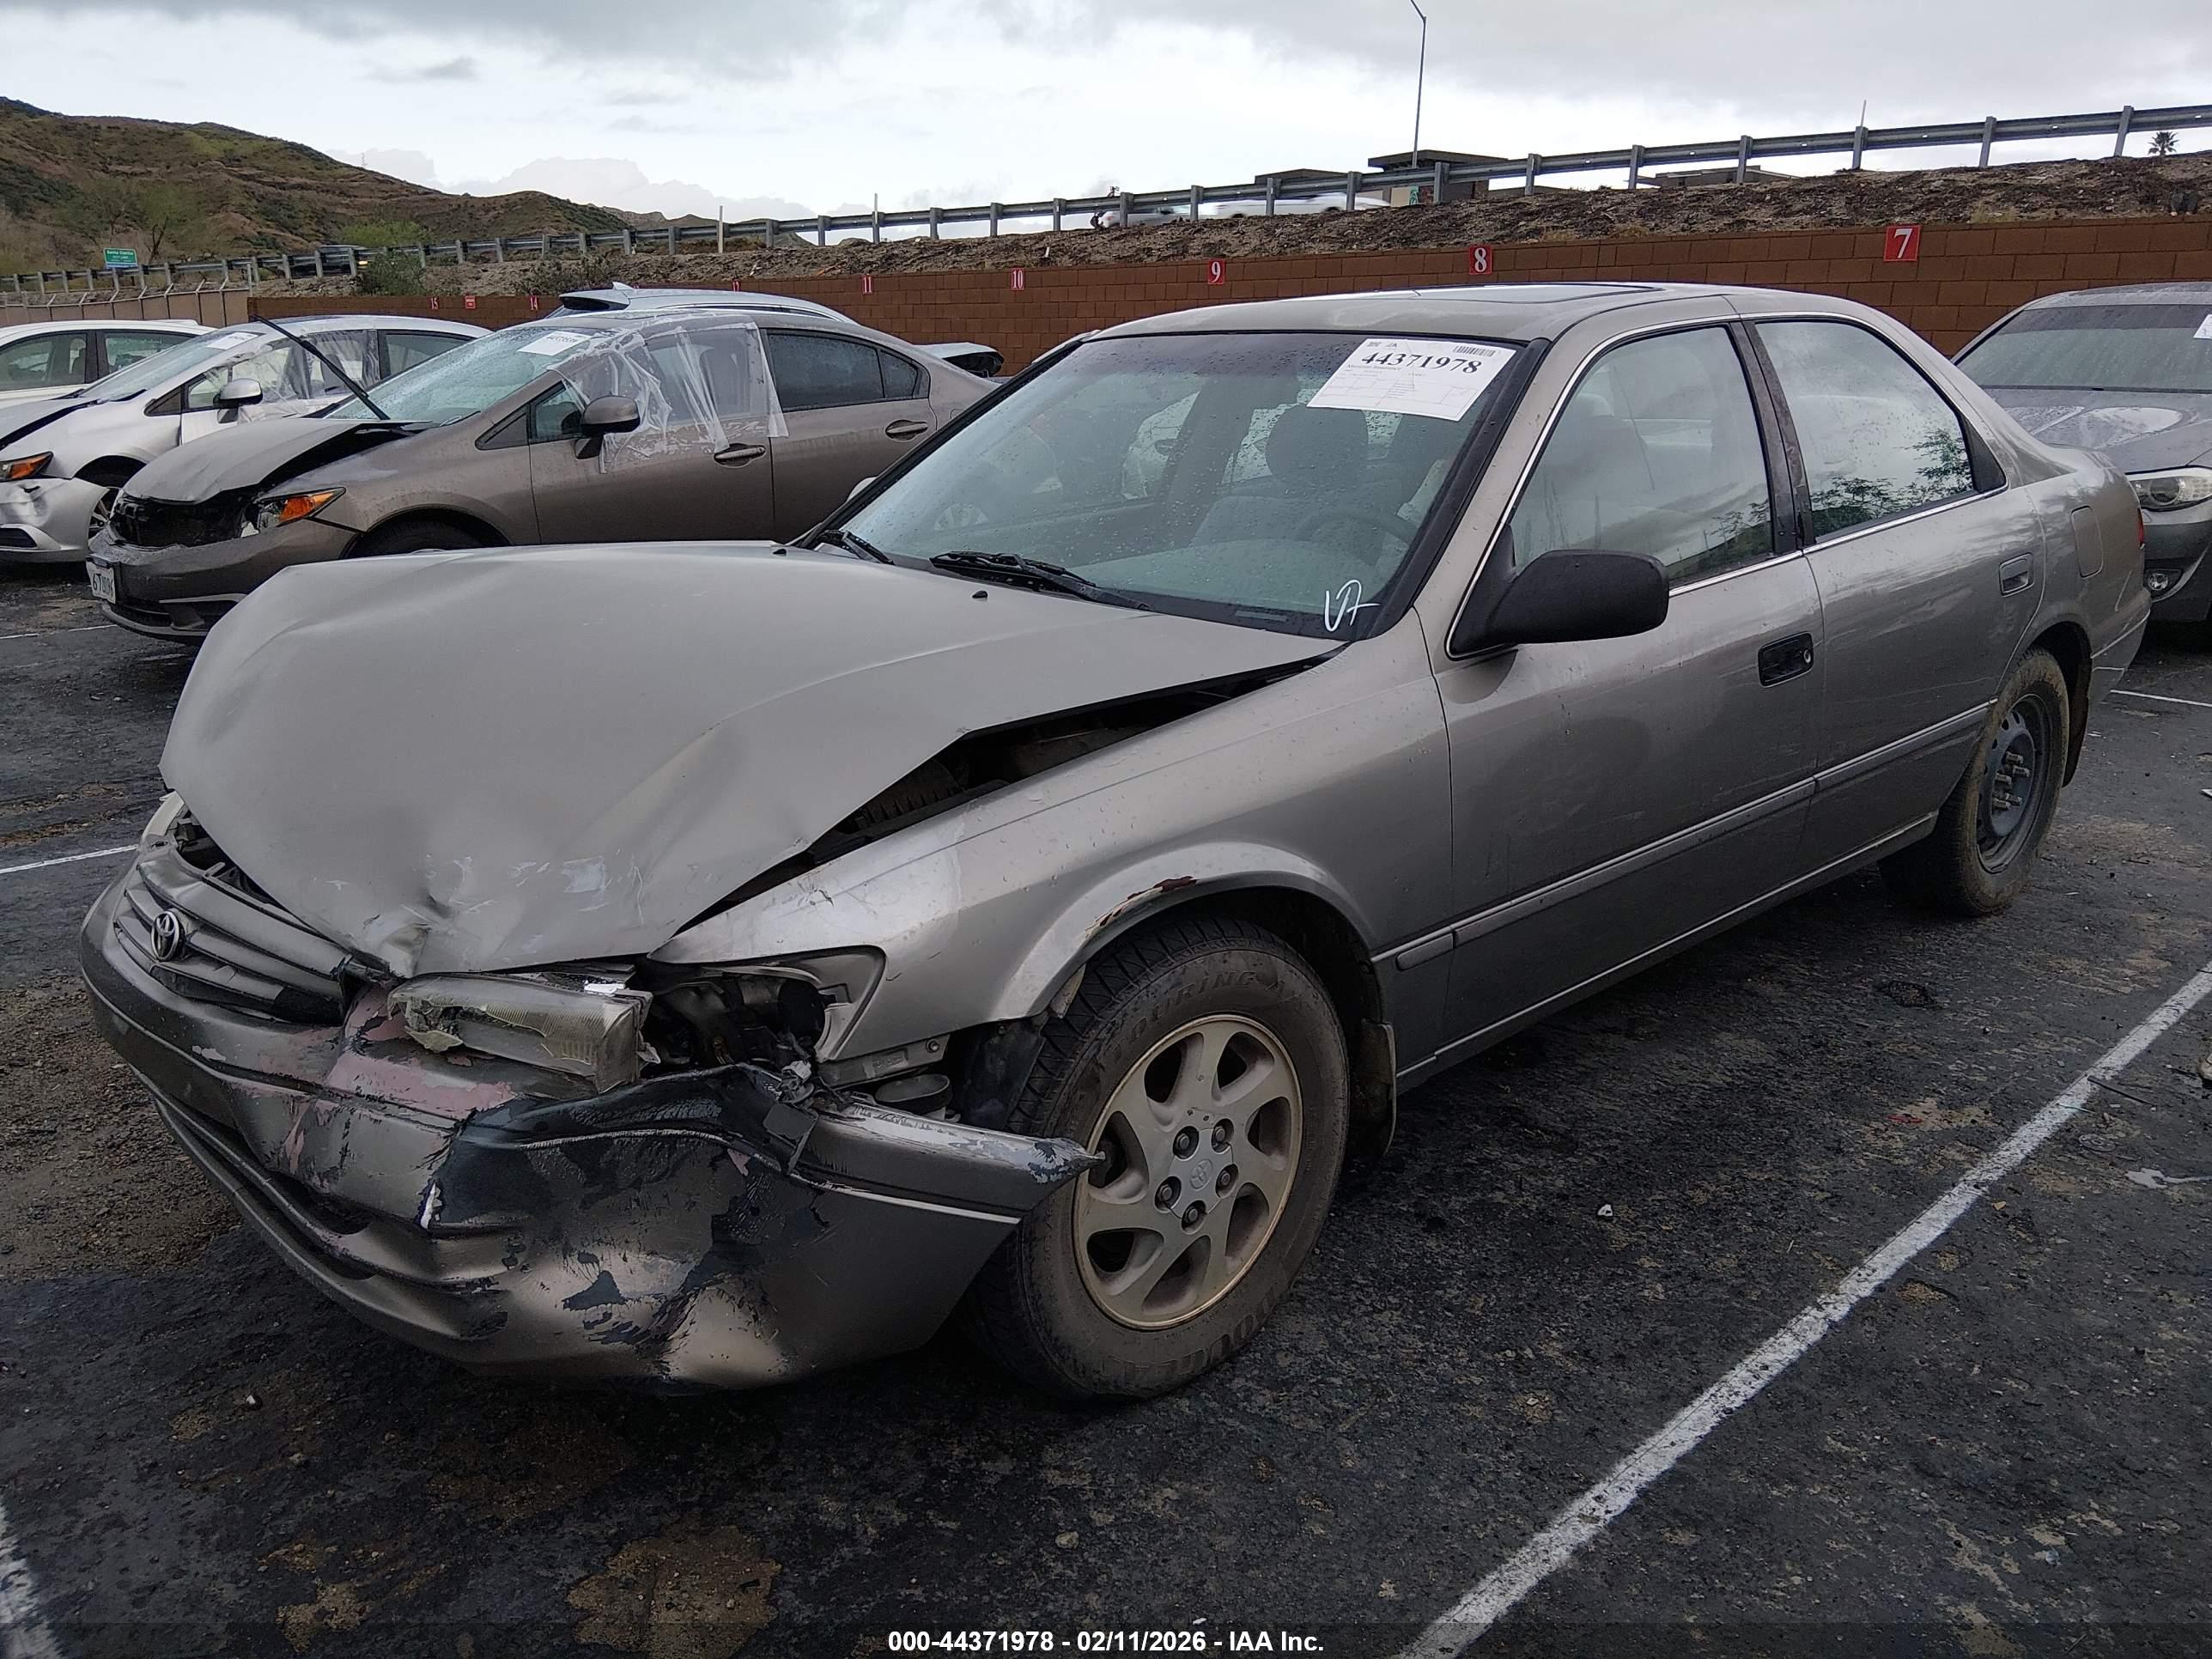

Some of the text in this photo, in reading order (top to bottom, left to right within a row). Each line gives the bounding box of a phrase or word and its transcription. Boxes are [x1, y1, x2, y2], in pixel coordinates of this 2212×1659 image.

[1893, 228, 1913, 258] 7
[1474, 247, 1486, 272] 8
[1012, 270, 1024, 289] 10
[1211, 261, 1221, 283] 9
[863, 276, 872, 294] 11
[430, 297, 438, 310] 15
[530, 296, 538, 310] 14
[1361, 352, 1483, 374] 44371978
